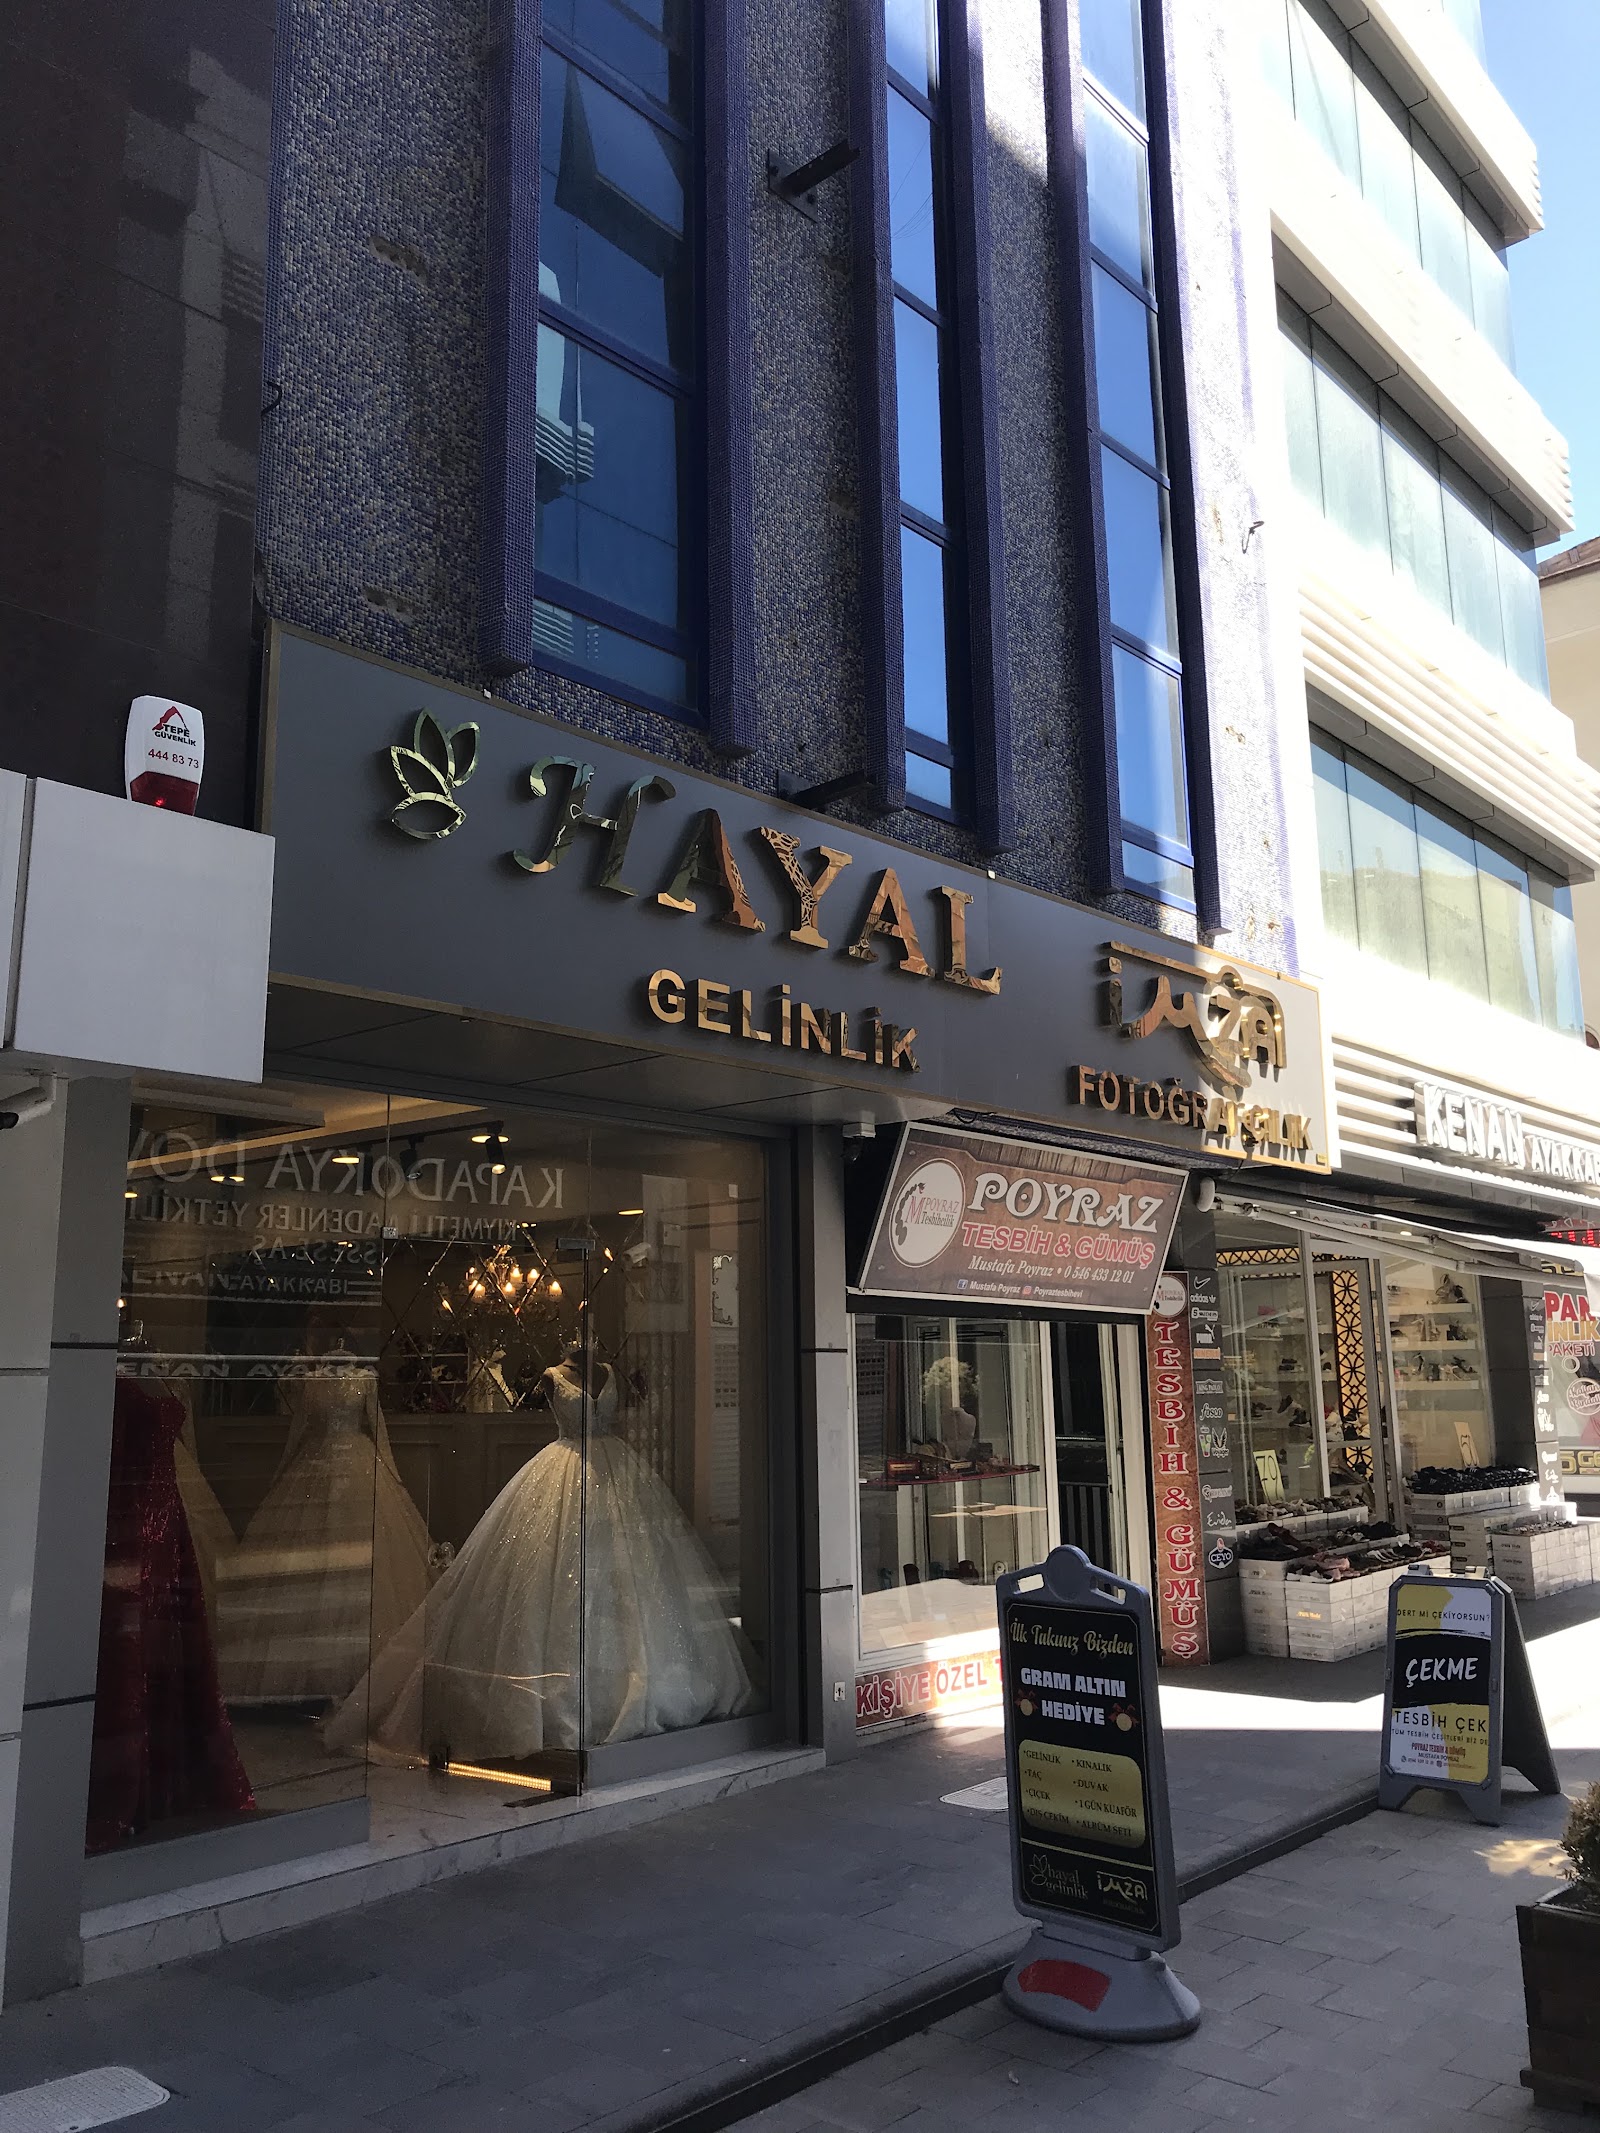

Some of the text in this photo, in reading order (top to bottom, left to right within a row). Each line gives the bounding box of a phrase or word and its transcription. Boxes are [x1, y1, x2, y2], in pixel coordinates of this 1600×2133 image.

[154, 731, 197, 747] GÜVENLİK
[163, 723, 190, 738] TEPE
[148, 748, 199, 769] 444 83 73
[513, 755, 1003, 996] HAYAL
[648, 968, 921, 1073] GELİNLİK
[1415, 1082, 1526, 1169] KENAN
[924, 1197, 960, 1214] POYRAZ
[967, 1172, 1164, 1234] POYRAZ
[961, 1221, 1156, 1269] TESBİH & GÜMÜŞ
[968, 1255, 1135, 1284] Mustafa Poyraz 0 546 433 12 01
[970, 1281, 1021, 1296] Mustafa Poyraz
[1033, 1286, 1083, 1299] Poyraztesbihevi
[1153, 1321, 1201, 1659] TESBİH & GÜMÜŞ
[1210, 1552, 1232, 1562] CEYO
[1010, 1618, 1028, 1643] İlk
[1084, 1630, 1134, 1658] Bizden
[1020, 1667, 1071, 1691] GRAM
[1075, 1675, 1126, 1698] ALTIN
[1405, 1657, 1478, 1688] ÇEKME
[856, 1671, 931, 1718] KİŞİYE
[935, 1662, 988, 1695] ÖZEL
[1041, 1700, 1105, 1726] HEDİYE
[1395, 1710, 1486, 1734] TESBİH ÇEK
[1407, 1730, 1429, 1739] TESBİH
[1411, 1742, 1428, 1752] POYRAZ
[1027, 1769, 1042, 1781] TAÇ
[1076, 1759, 1112, 1773] KINALIK
[1078, 1780, 1109, 1792] DUVAK
[1084, 1800, 1102, 1811] GÜN
[1104, 1803, 1137, 1817] KUAFÖR
[1047, 1864, 1080, 1885] hayal
